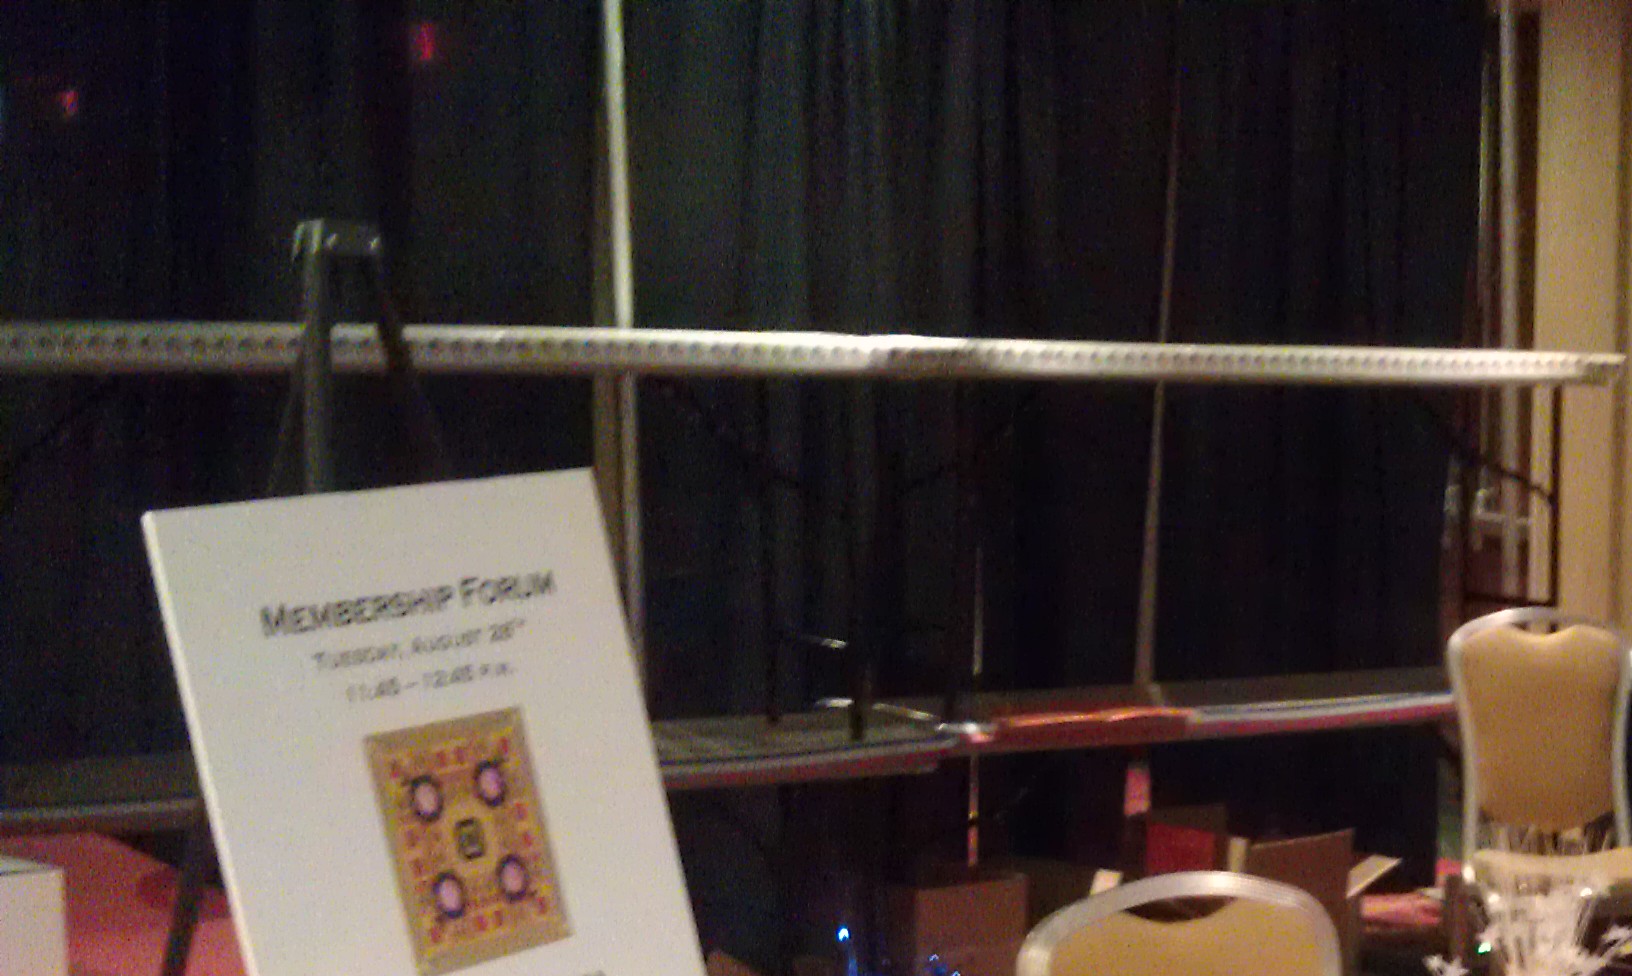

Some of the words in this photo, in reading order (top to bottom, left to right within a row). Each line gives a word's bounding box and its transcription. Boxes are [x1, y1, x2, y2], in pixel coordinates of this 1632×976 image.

[260, 584, 454, 638] MEMBERSHIP
[458, 570, 556, 608] FORUM
[410, 627, 482, 654] AUGUST
